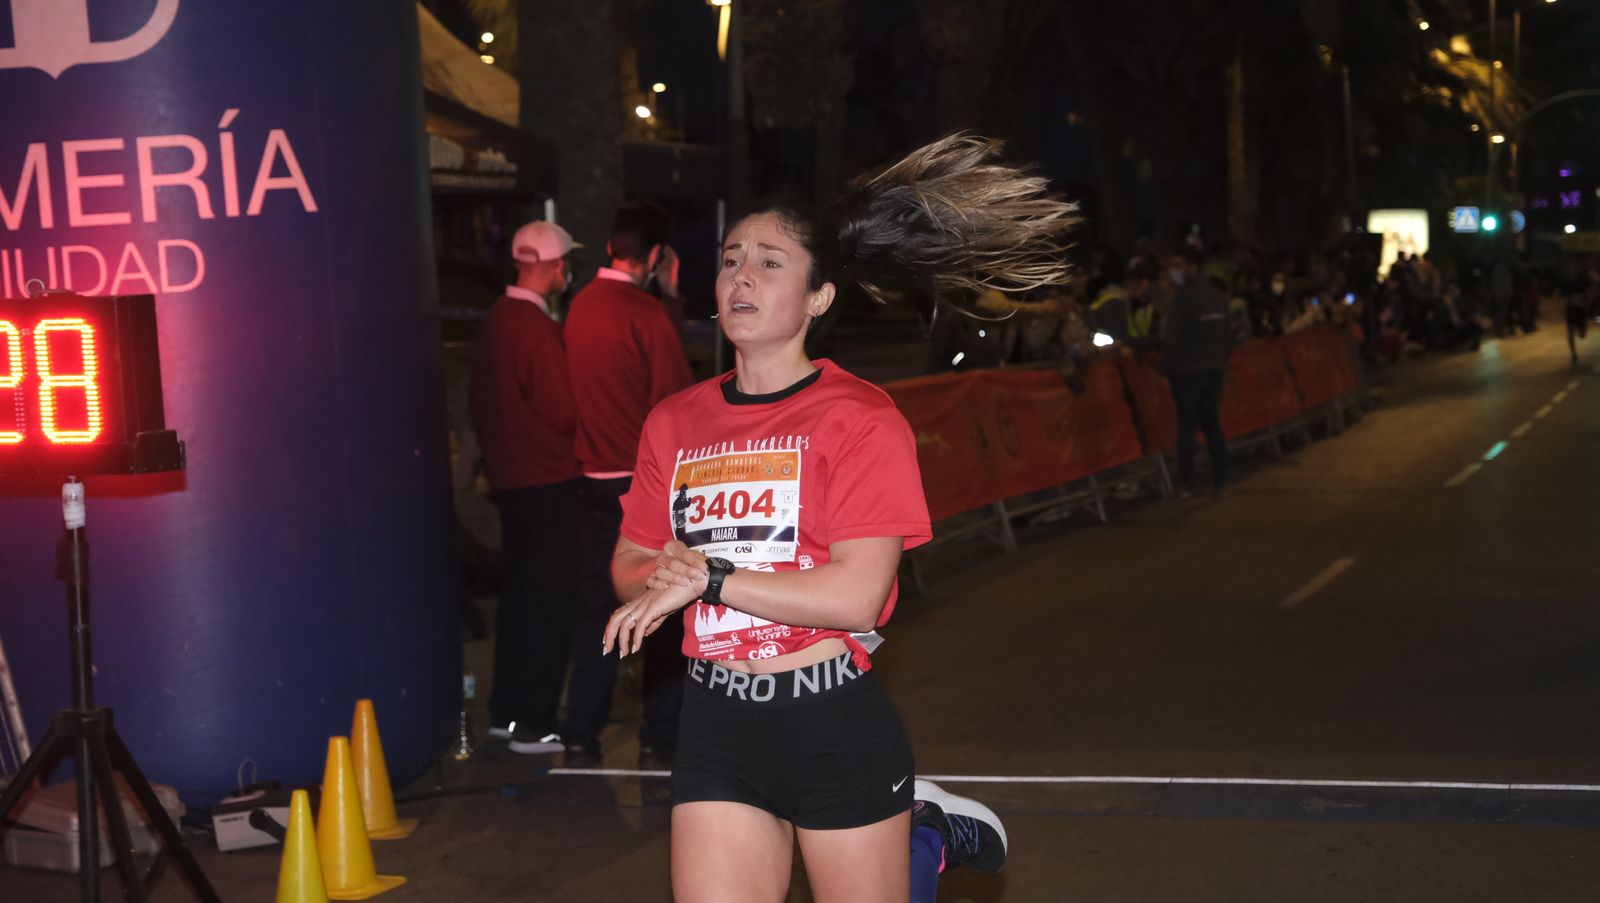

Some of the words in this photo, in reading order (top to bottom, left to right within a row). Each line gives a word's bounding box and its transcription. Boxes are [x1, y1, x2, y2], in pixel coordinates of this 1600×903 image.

[0, 108, 319, 230] MERÍA
[686, 441, 735, 461] CARRERA
[746, 435, 810, 452] BOMBEROS
[725, 457, 762, 467] BOMBEROS
[688, 488, 776, 525] 3404
[710, 527, 738, 542] NAIARA
[734, 546, 753, 554] CASI
[748, 645, 778, 660] CASI
[709, 664, 776, 702] PRO
[793, 651, 865, 698] NIK
